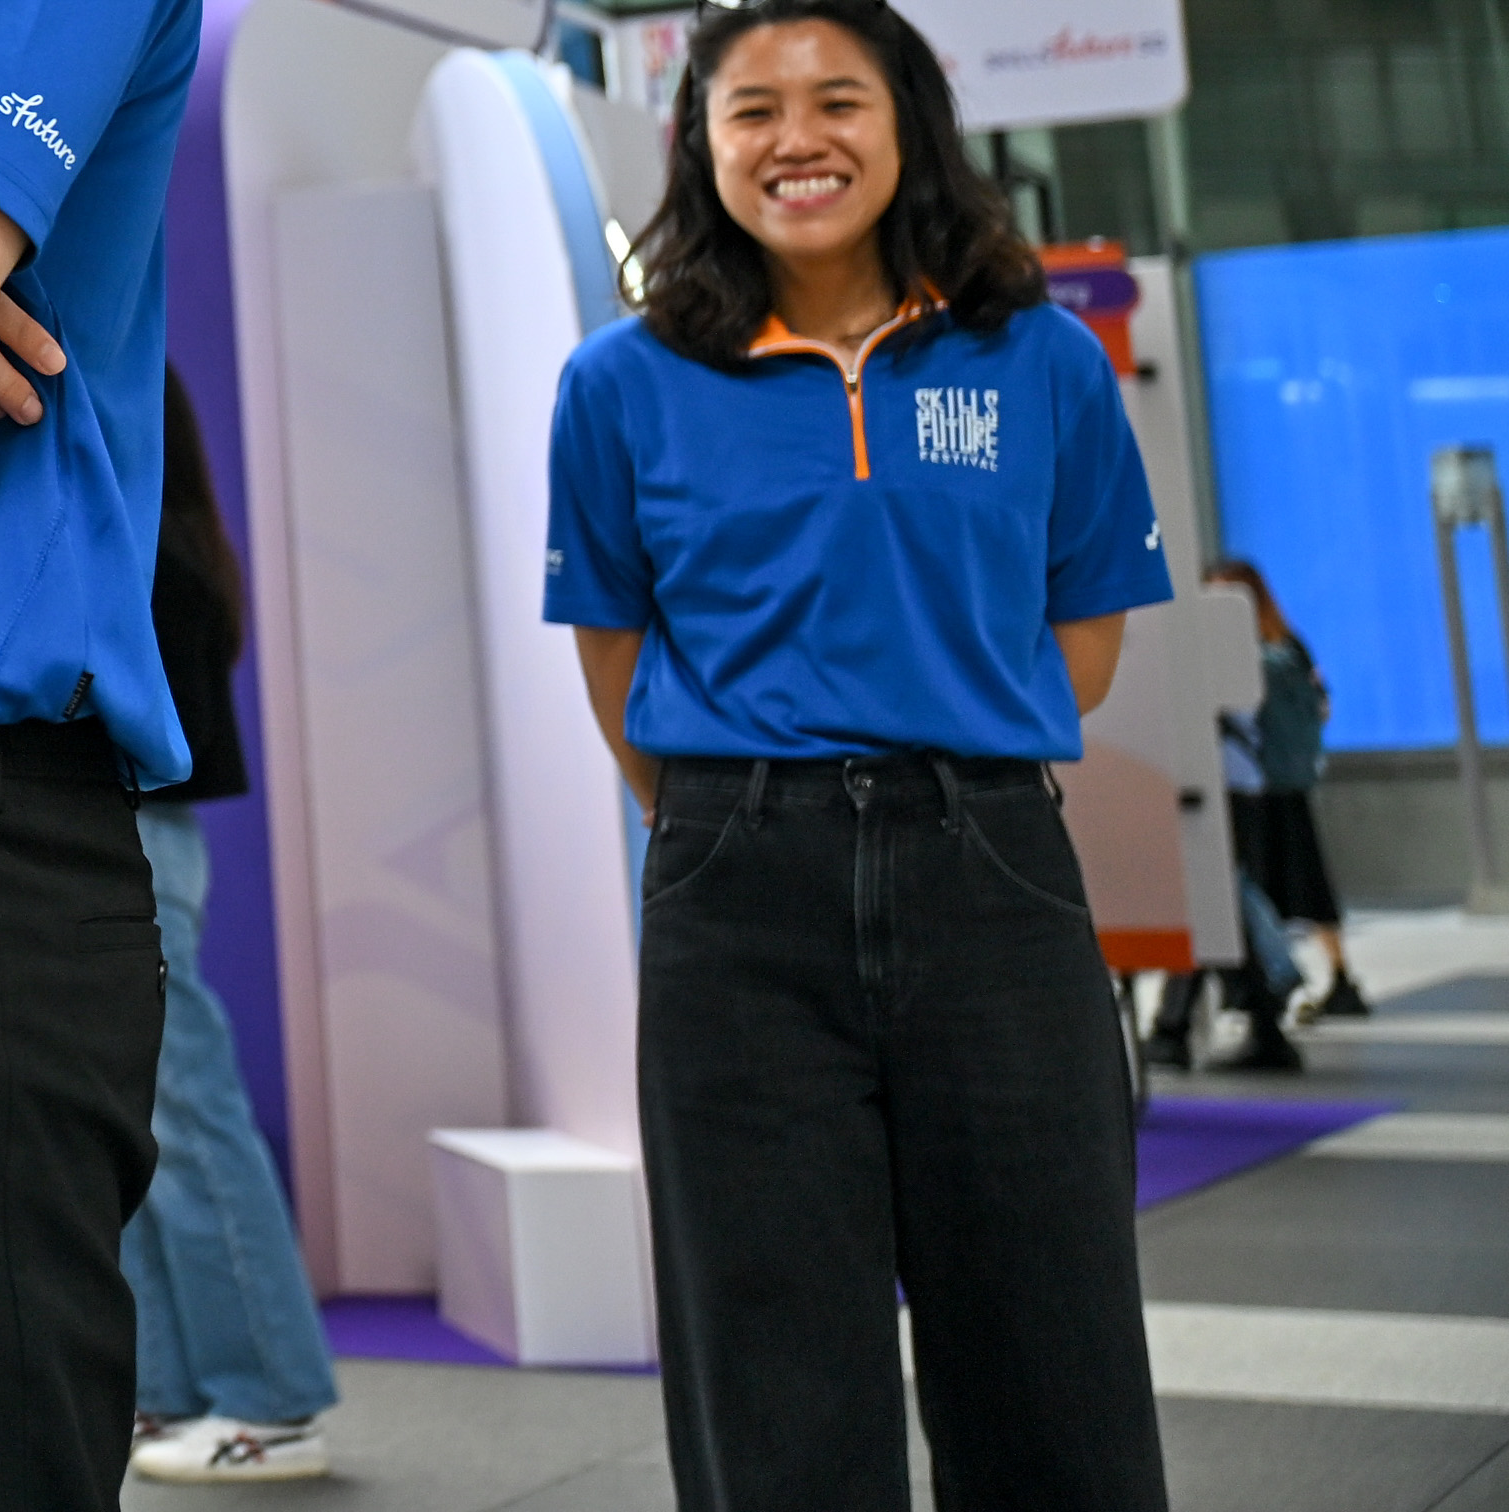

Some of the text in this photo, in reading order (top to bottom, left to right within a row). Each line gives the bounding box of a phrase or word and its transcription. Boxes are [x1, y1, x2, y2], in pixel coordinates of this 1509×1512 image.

[915, 387, 999, 425] SKILLS
[916, 408, 999, 460] FUTURE
[919, 448, 999, 472] FESTIVAL
